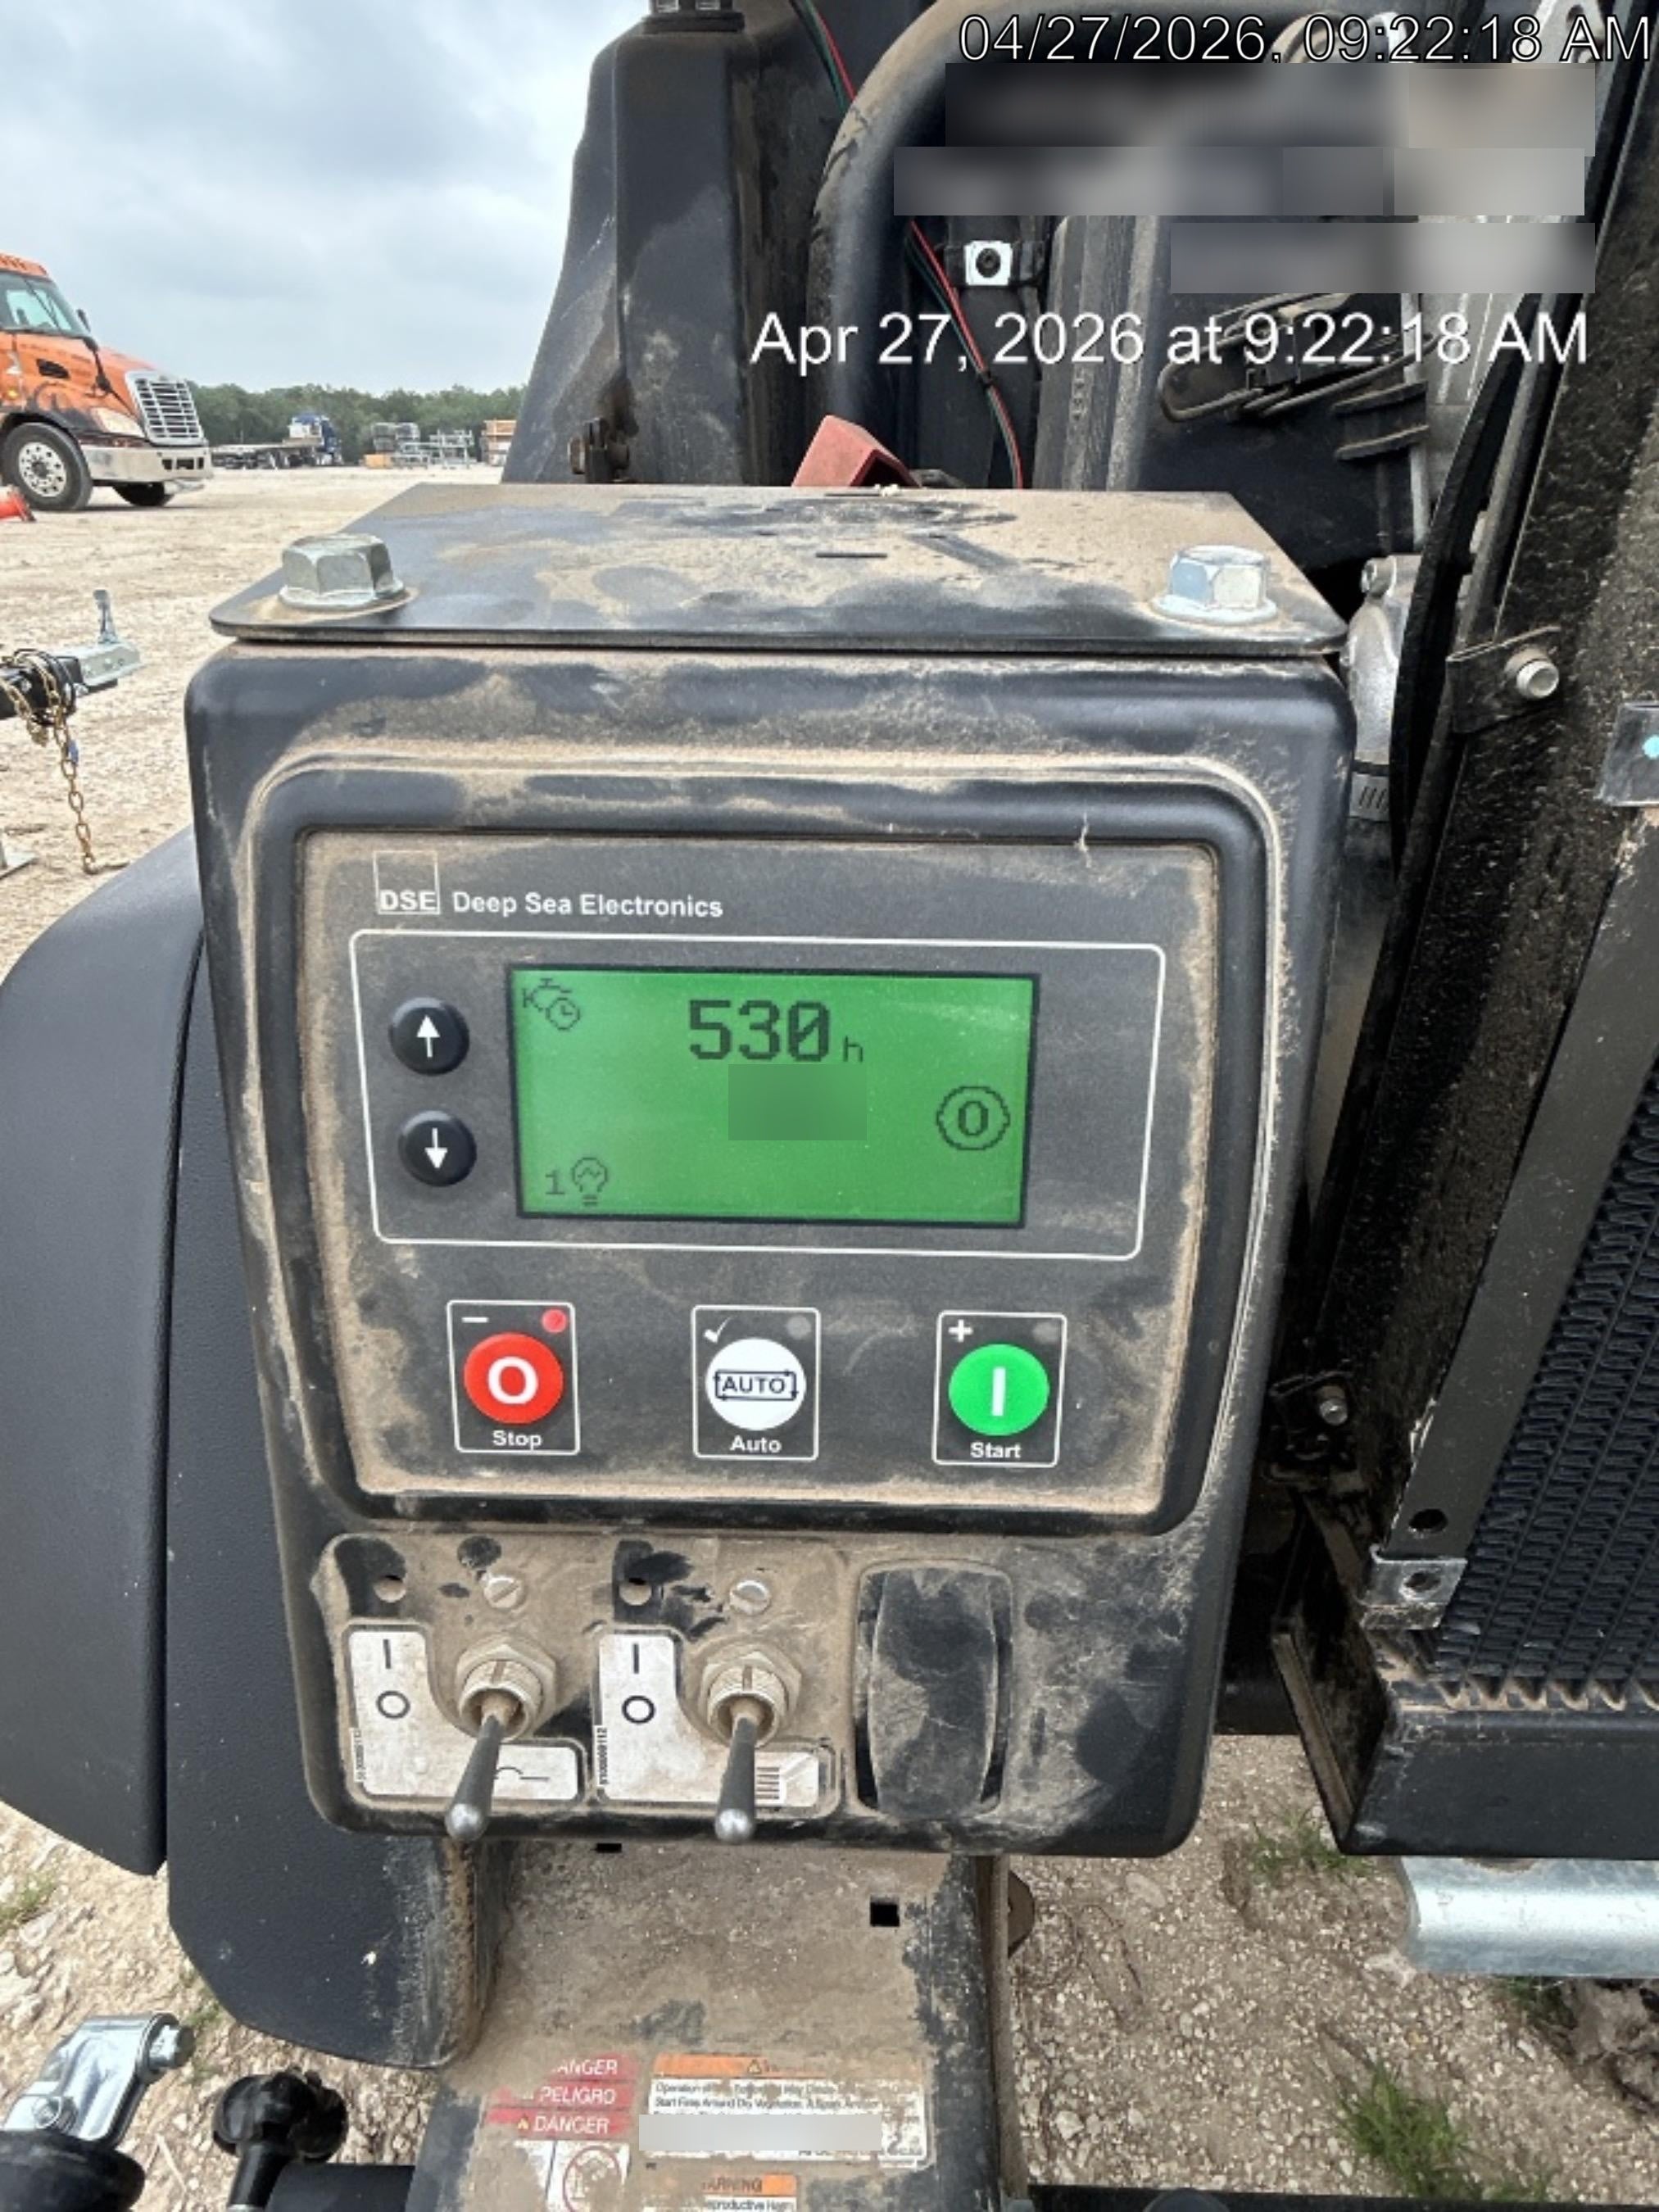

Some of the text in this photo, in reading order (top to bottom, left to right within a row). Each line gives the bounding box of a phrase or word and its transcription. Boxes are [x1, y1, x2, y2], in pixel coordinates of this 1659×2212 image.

[379, 890, 723, 918] DSE Deep Sea Electronics
[690, 999, 830, 1062] 530
[721, 1376, 786, 1394] AUTO
[492, 1430, 542, 1450] Stop
[730, 1435, 782, 1454] Auto
[969, 1441, 1022, 1459] Start
[552, 2058, 618, 2076] ANGER
[539, 2086, 617, 2105] PELIGRO
[533, 2115, 610, 2135] DANGER
[702, 2177, 763, 2193] ARNING
